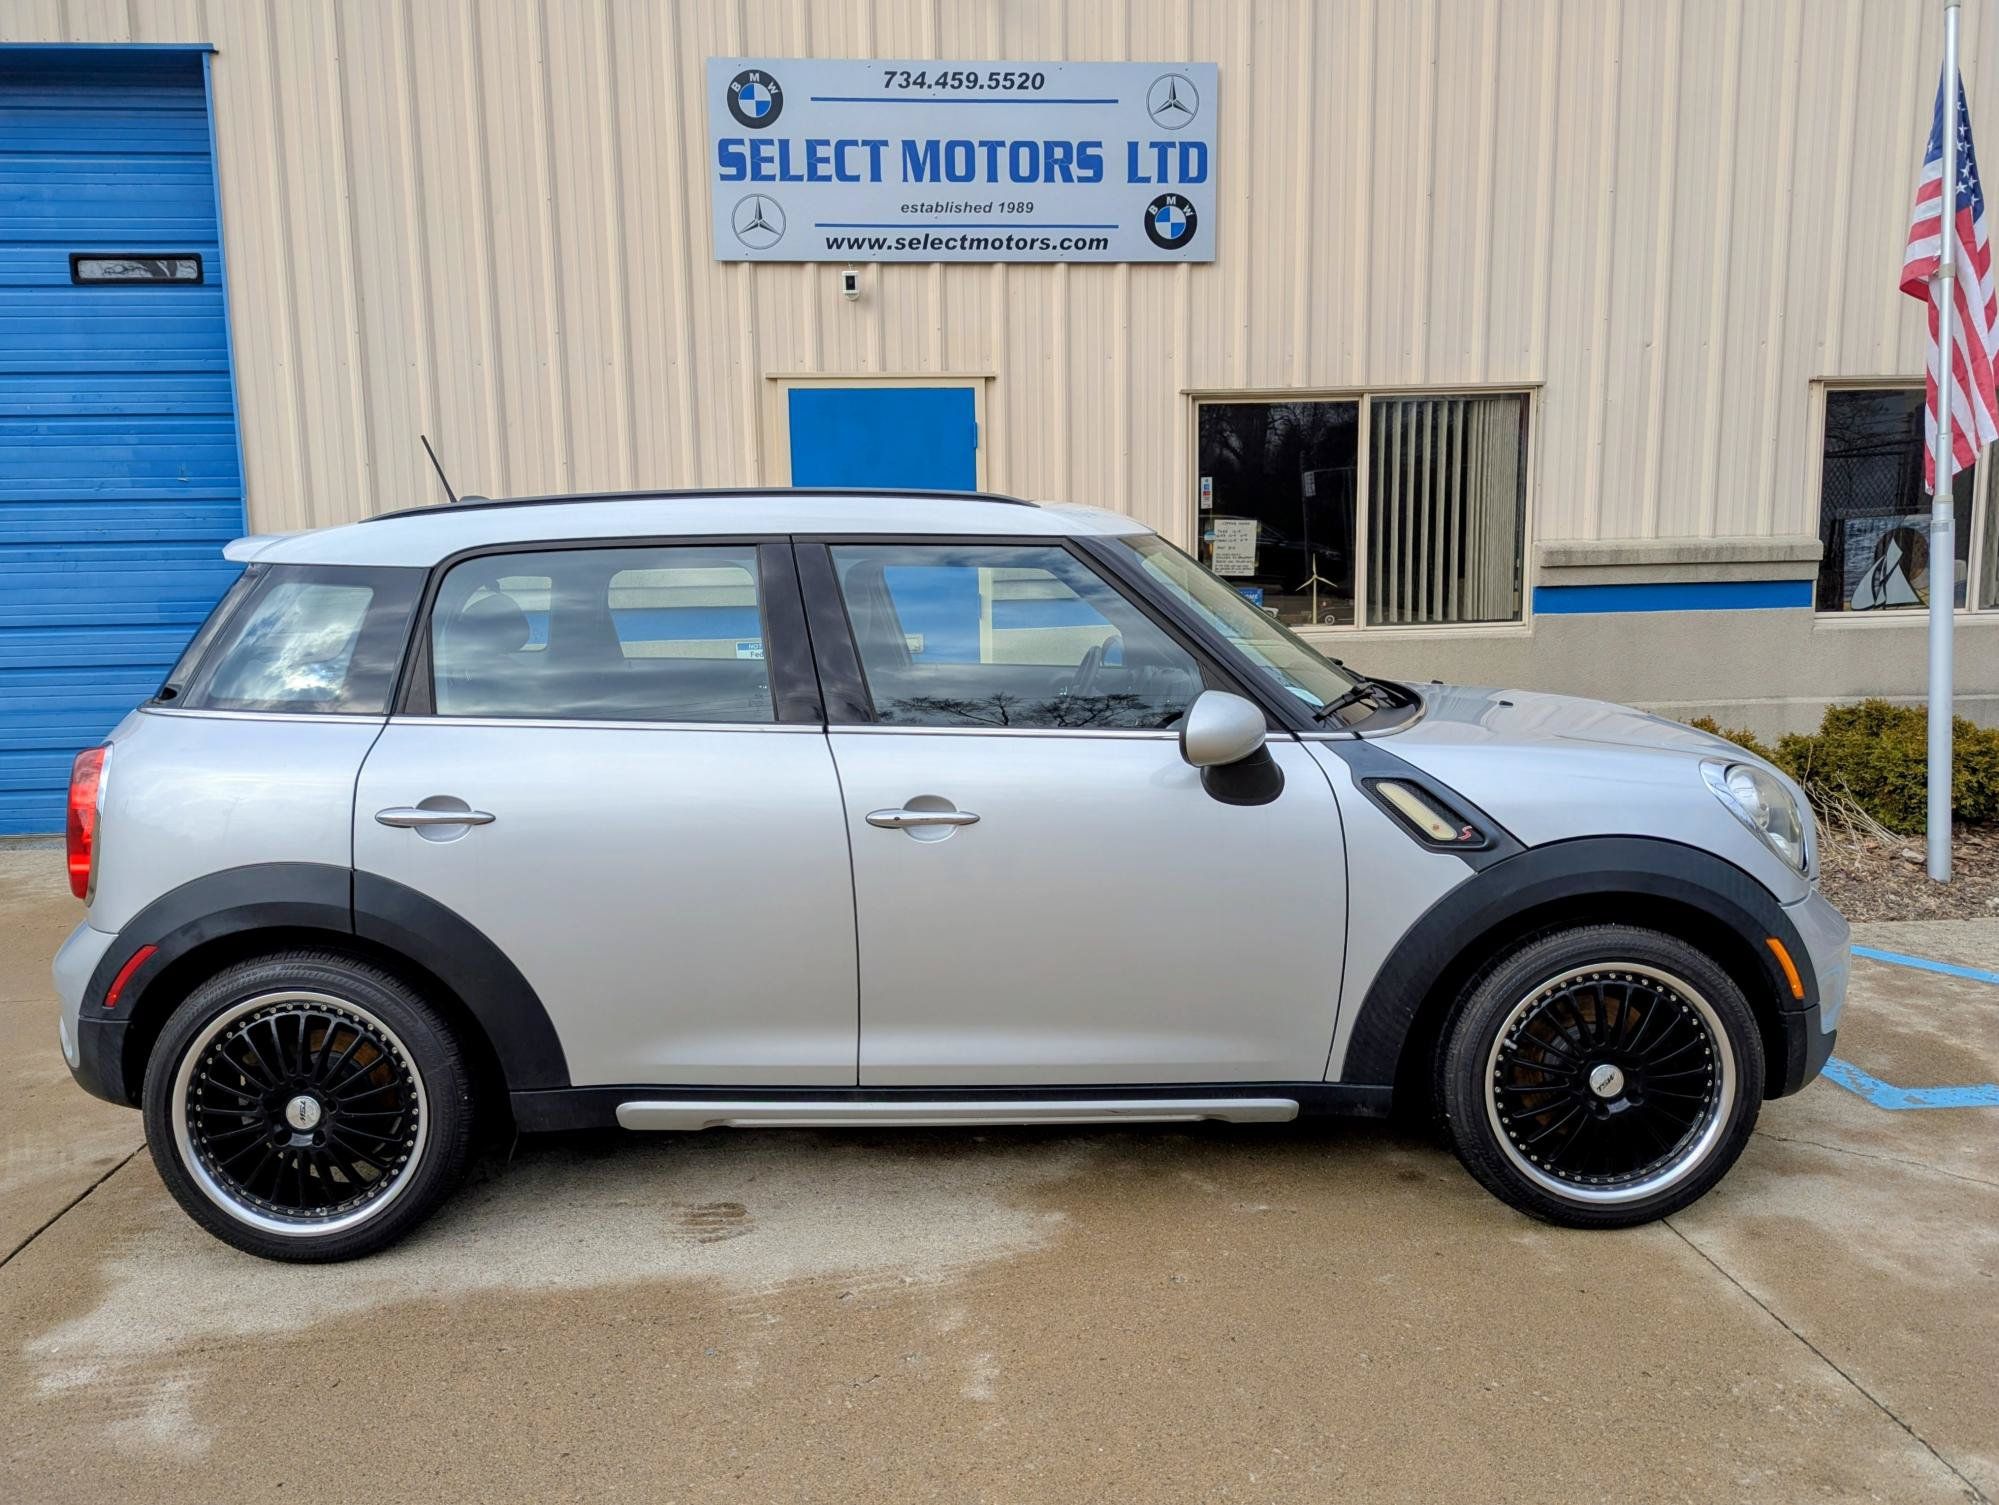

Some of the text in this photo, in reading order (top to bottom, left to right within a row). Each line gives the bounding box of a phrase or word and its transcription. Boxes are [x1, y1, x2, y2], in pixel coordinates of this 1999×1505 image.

[730, 72, 779, 94] BMW
[883, 70, 1045, 91] 734.459.5520
[718, 138, 1208, 184] SELECT MOTORS LTD
[900, 201, 1034, 214] established 1989
[1148, 196, 1195, 217] BMW
[825, 233, 1109, 251] www.selectmotors.com
